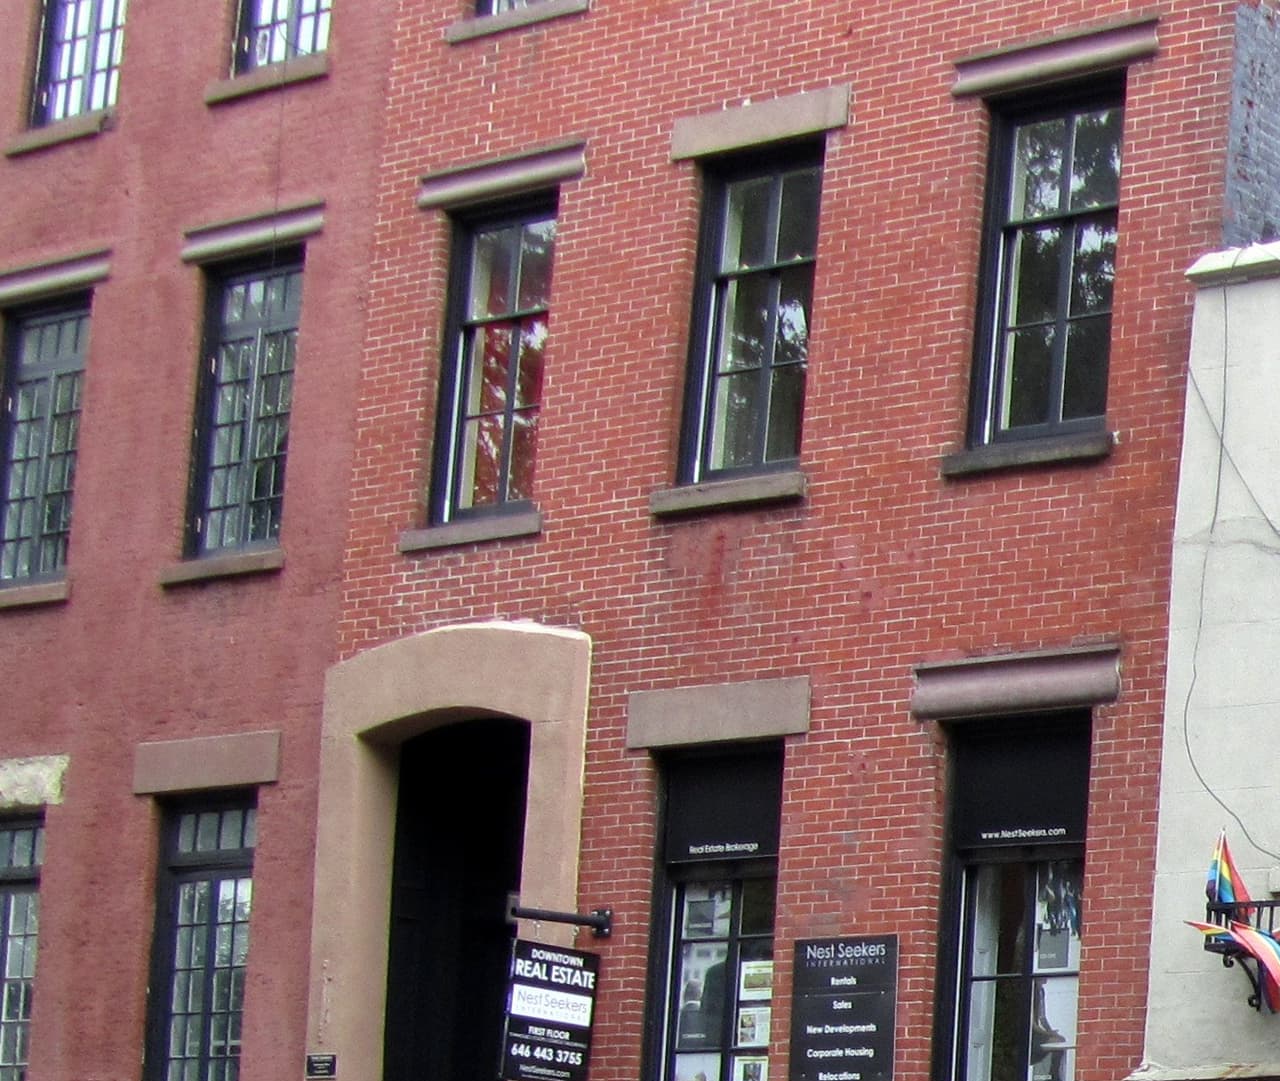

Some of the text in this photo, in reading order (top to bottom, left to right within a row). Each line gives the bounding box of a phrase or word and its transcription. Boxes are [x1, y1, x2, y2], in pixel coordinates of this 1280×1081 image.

[689, 845, 704, 854] Real
[705, 845, 725, 853] Estate
[806, 942, 886, 959] Nest Seekers
[531, 948, 584, 967] DOWNTOWN
[515, 958, 595, 989] REAL ESTATE
[830, 976, 857, 986] Rentals
[833, 1000, 852, 1009] Sales
[546, 1028, 570, 1041] FLOOR
[806, 1023, 877, 1034] New Developments
[511, 1043, 583, 1066] 646 443 3755
[806, 1047, 875, 1059] Corporate Housing
[818, 1072, 861, 1081] Relocations
